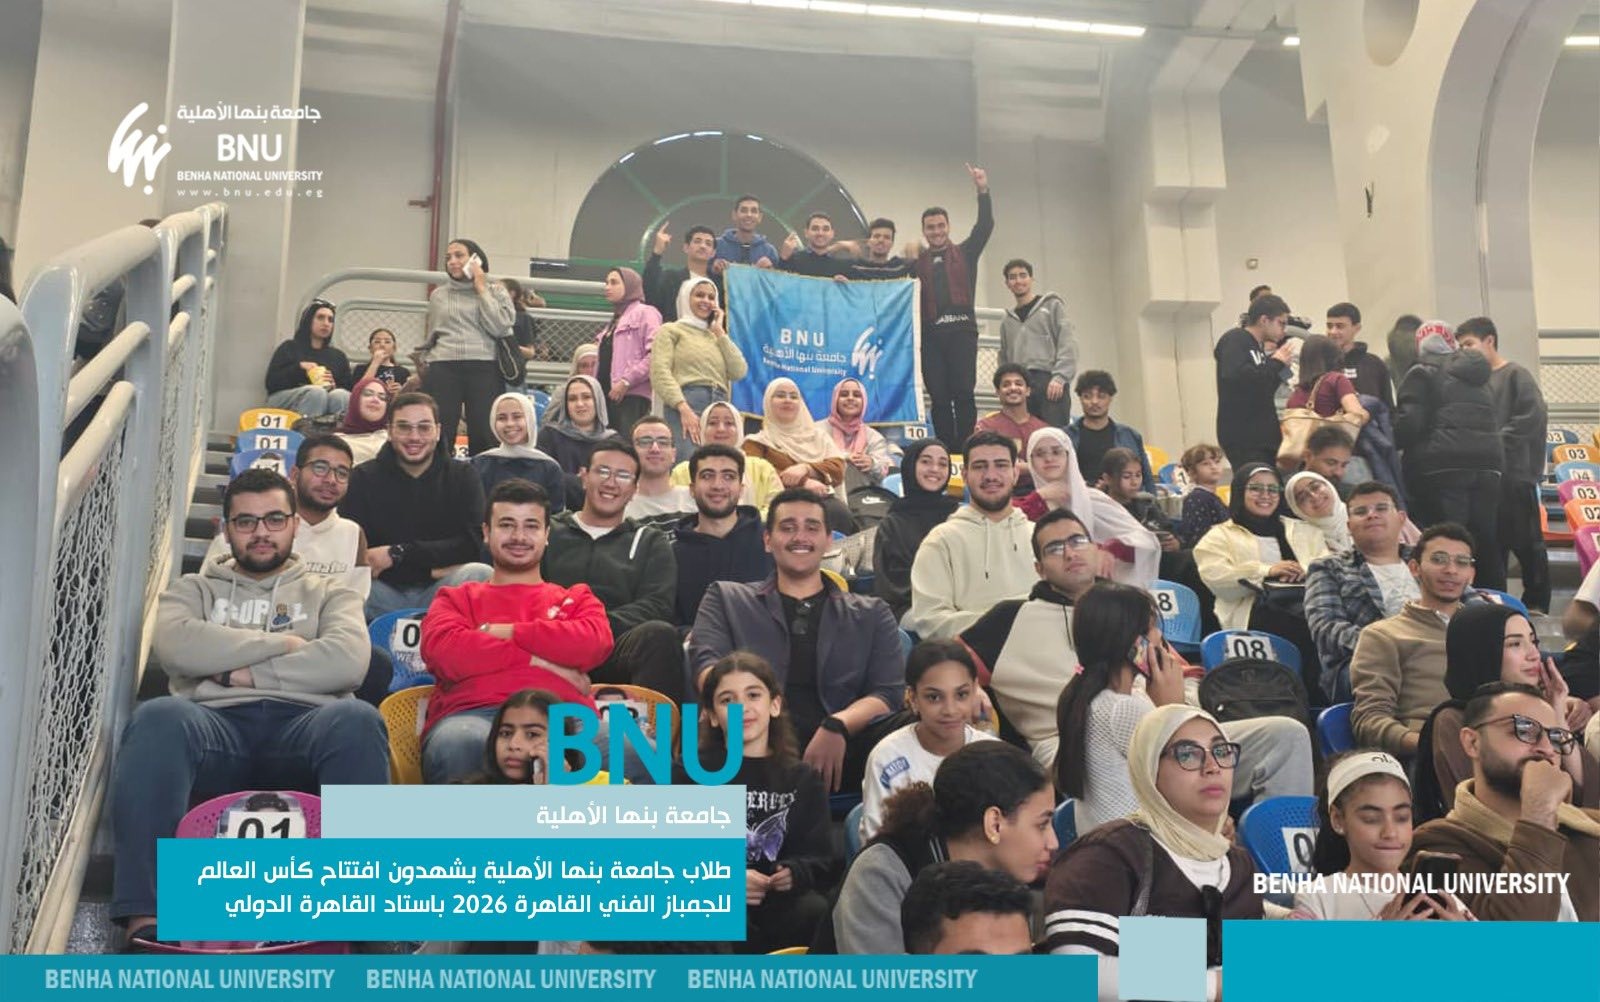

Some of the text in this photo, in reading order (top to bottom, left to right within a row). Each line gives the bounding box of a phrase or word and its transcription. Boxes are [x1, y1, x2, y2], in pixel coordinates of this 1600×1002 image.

[780, 328, 825, 347] BNU
[261, 415, 281, 428] 01
[908, 427, 925, 439] 10
[260, 437, 280, 449] 01
[1568, 448, 1586, 460] 03
[1577, 487, 1597, 500] 03
[1157, 592, 1173, 612] 8
[402, 623, 421, 648] 0
[1233, 639, 1267, 661] 08
[1293, 832, 1314, 868] 0
